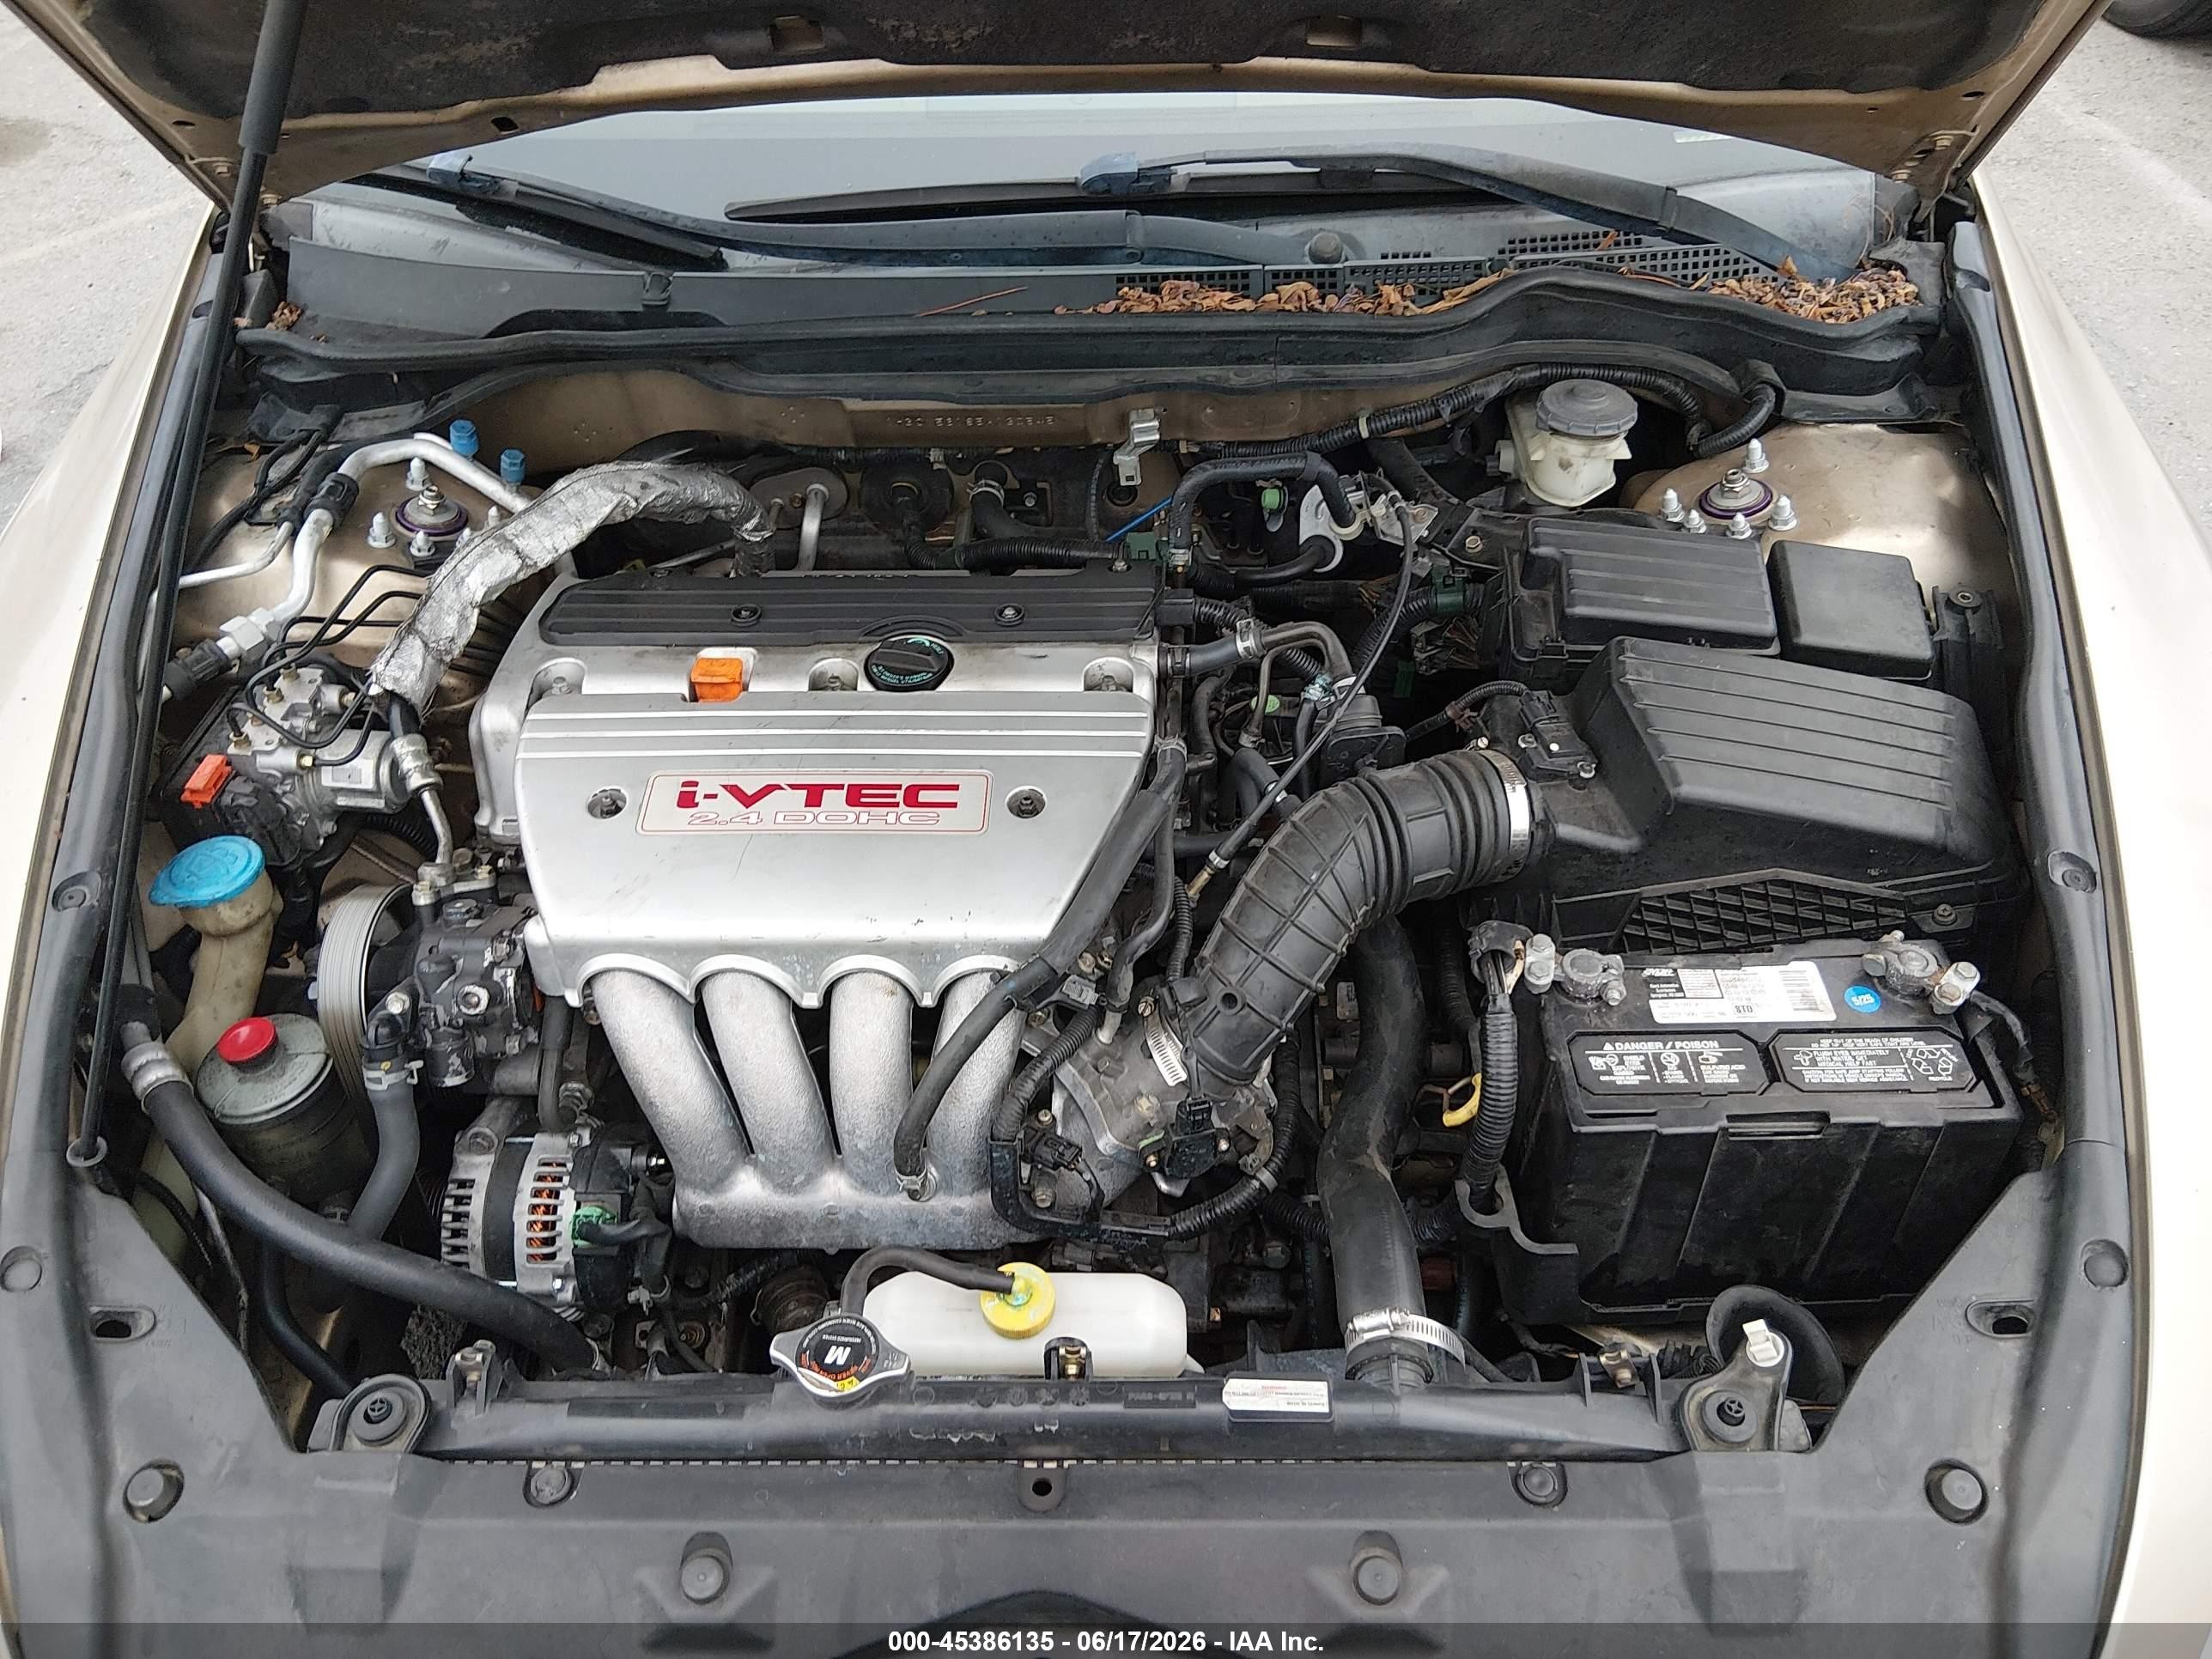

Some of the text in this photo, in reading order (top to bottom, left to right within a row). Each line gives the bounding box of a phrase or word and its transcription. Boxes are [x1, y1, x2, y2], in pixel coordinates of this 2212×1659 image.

[676, 780, 961, 809] i-VTEC
[687, 810, 941, 826] 2.4 DOHC
[1851, 994, 1875, 1006] 5/25
[1614, 1042, 1664, 1051] DANGER
[1674, 1040, 1719, 1049] POISON
[824, 1345, 852, 1365] M
